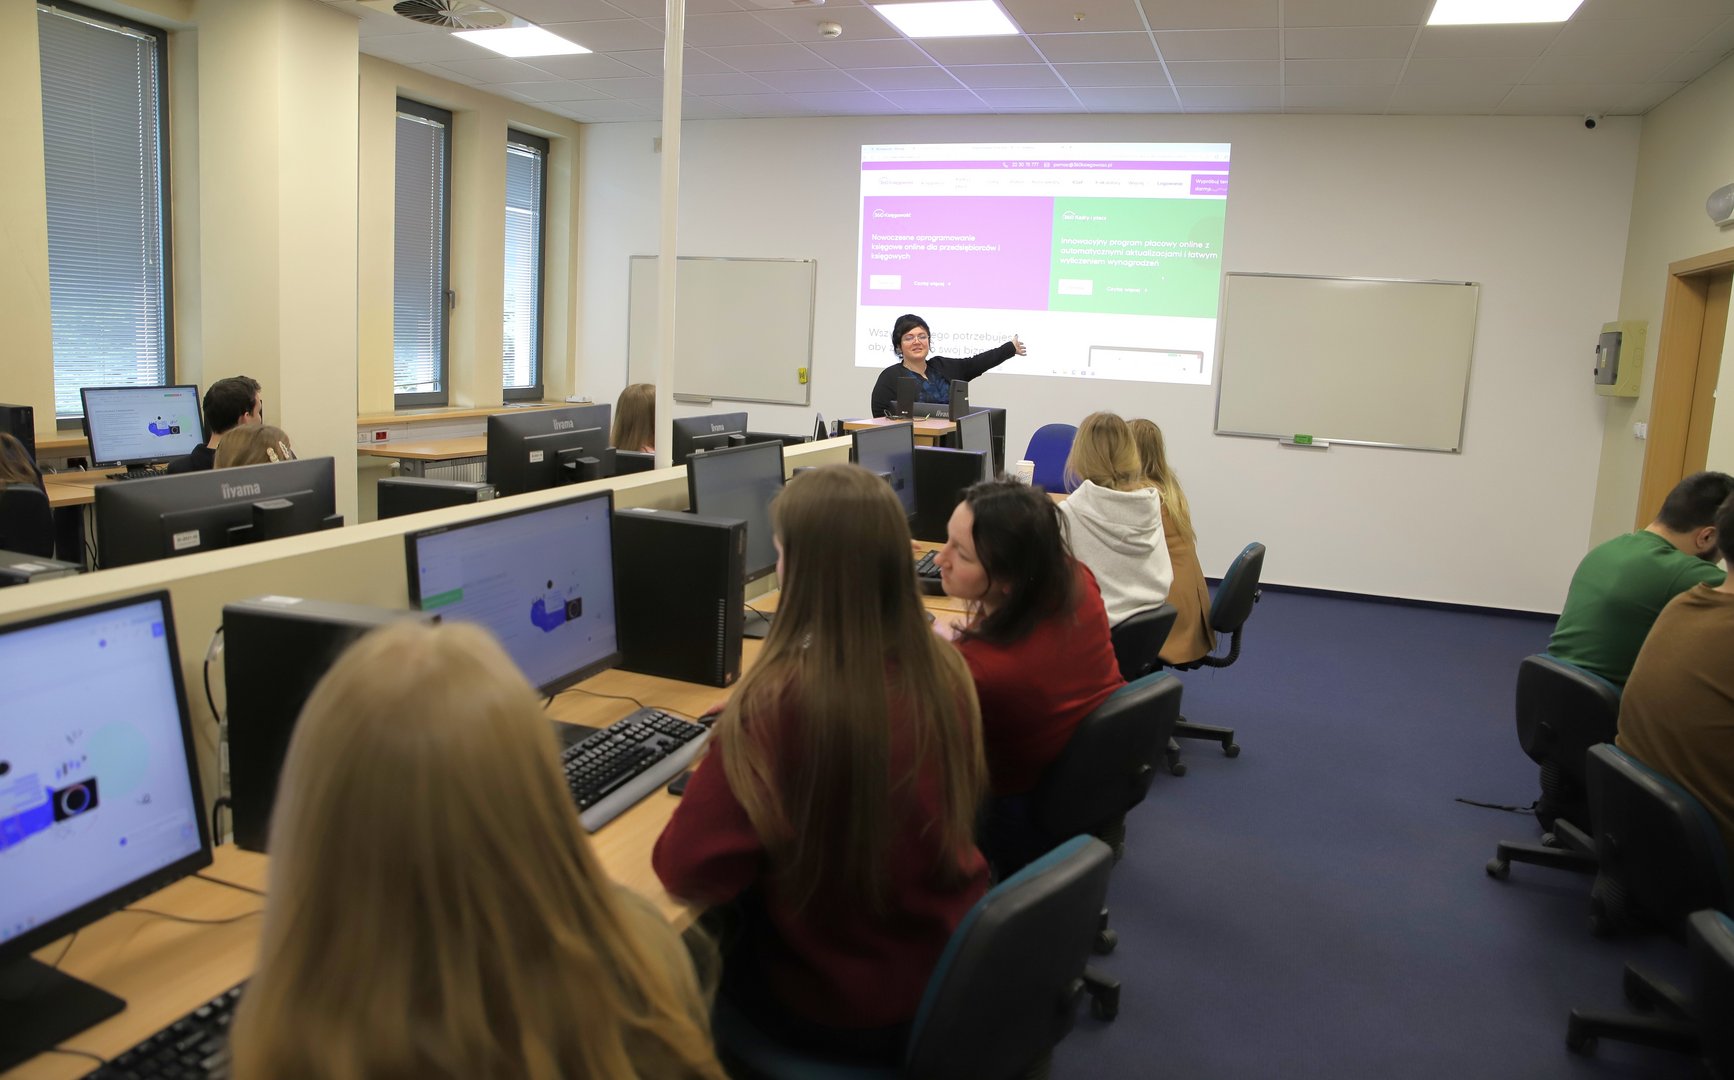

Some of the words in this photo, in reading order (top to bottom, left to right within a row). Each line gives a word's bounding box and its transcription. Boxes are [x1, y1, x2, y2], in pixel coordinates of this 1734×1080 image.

[916, 234, 976, 243] oprogramowanie
[1061, 237, 1107, 246] Innowacyjny
[1109, 239, 1142, 247] program
[1179, 240, 1203, 248] online
[904, 243, 925, 251] online
[1060, 248, 1124, 257] automatycznymi
[1125, 249, 1182, 258] aktualizacjami
[1060, 257, 1105, 266] wyliczeniem
[868, 343, 887, 352] aby
[221, 482, 261, 499] iiyama
